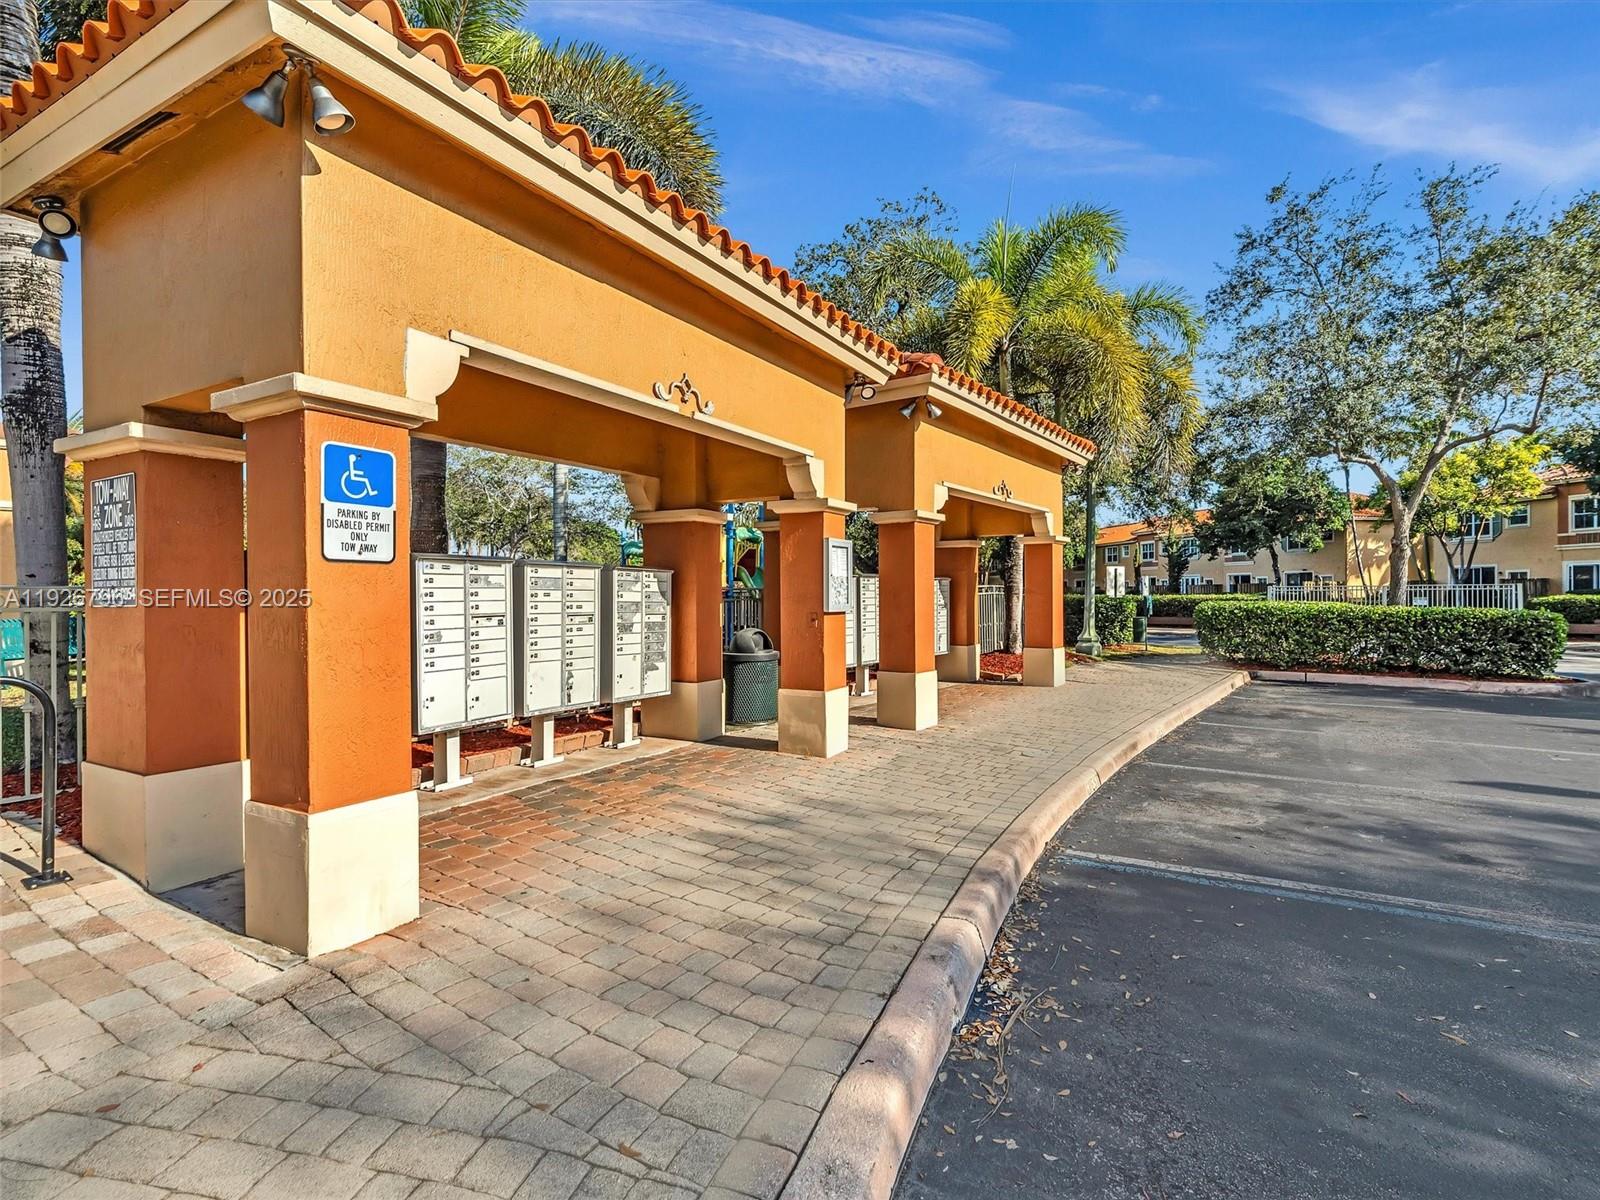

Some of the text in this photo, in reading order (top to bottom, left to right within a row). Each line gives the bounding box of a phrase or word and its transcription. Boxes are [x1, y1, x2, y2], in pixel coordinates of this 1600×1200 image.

[94, 476, 130, 505] TOW-AWAY
[104, 503, 122, 528] ZONE
[126, 500, 131, 514] 7
[337, 508, 381, 521] PARKING BY
[326, 518, 391, 533] DISABLED PERMIT
[350, 531, 369, 542] ONLY
[341, 542, 378, 553] TOW AWAY
